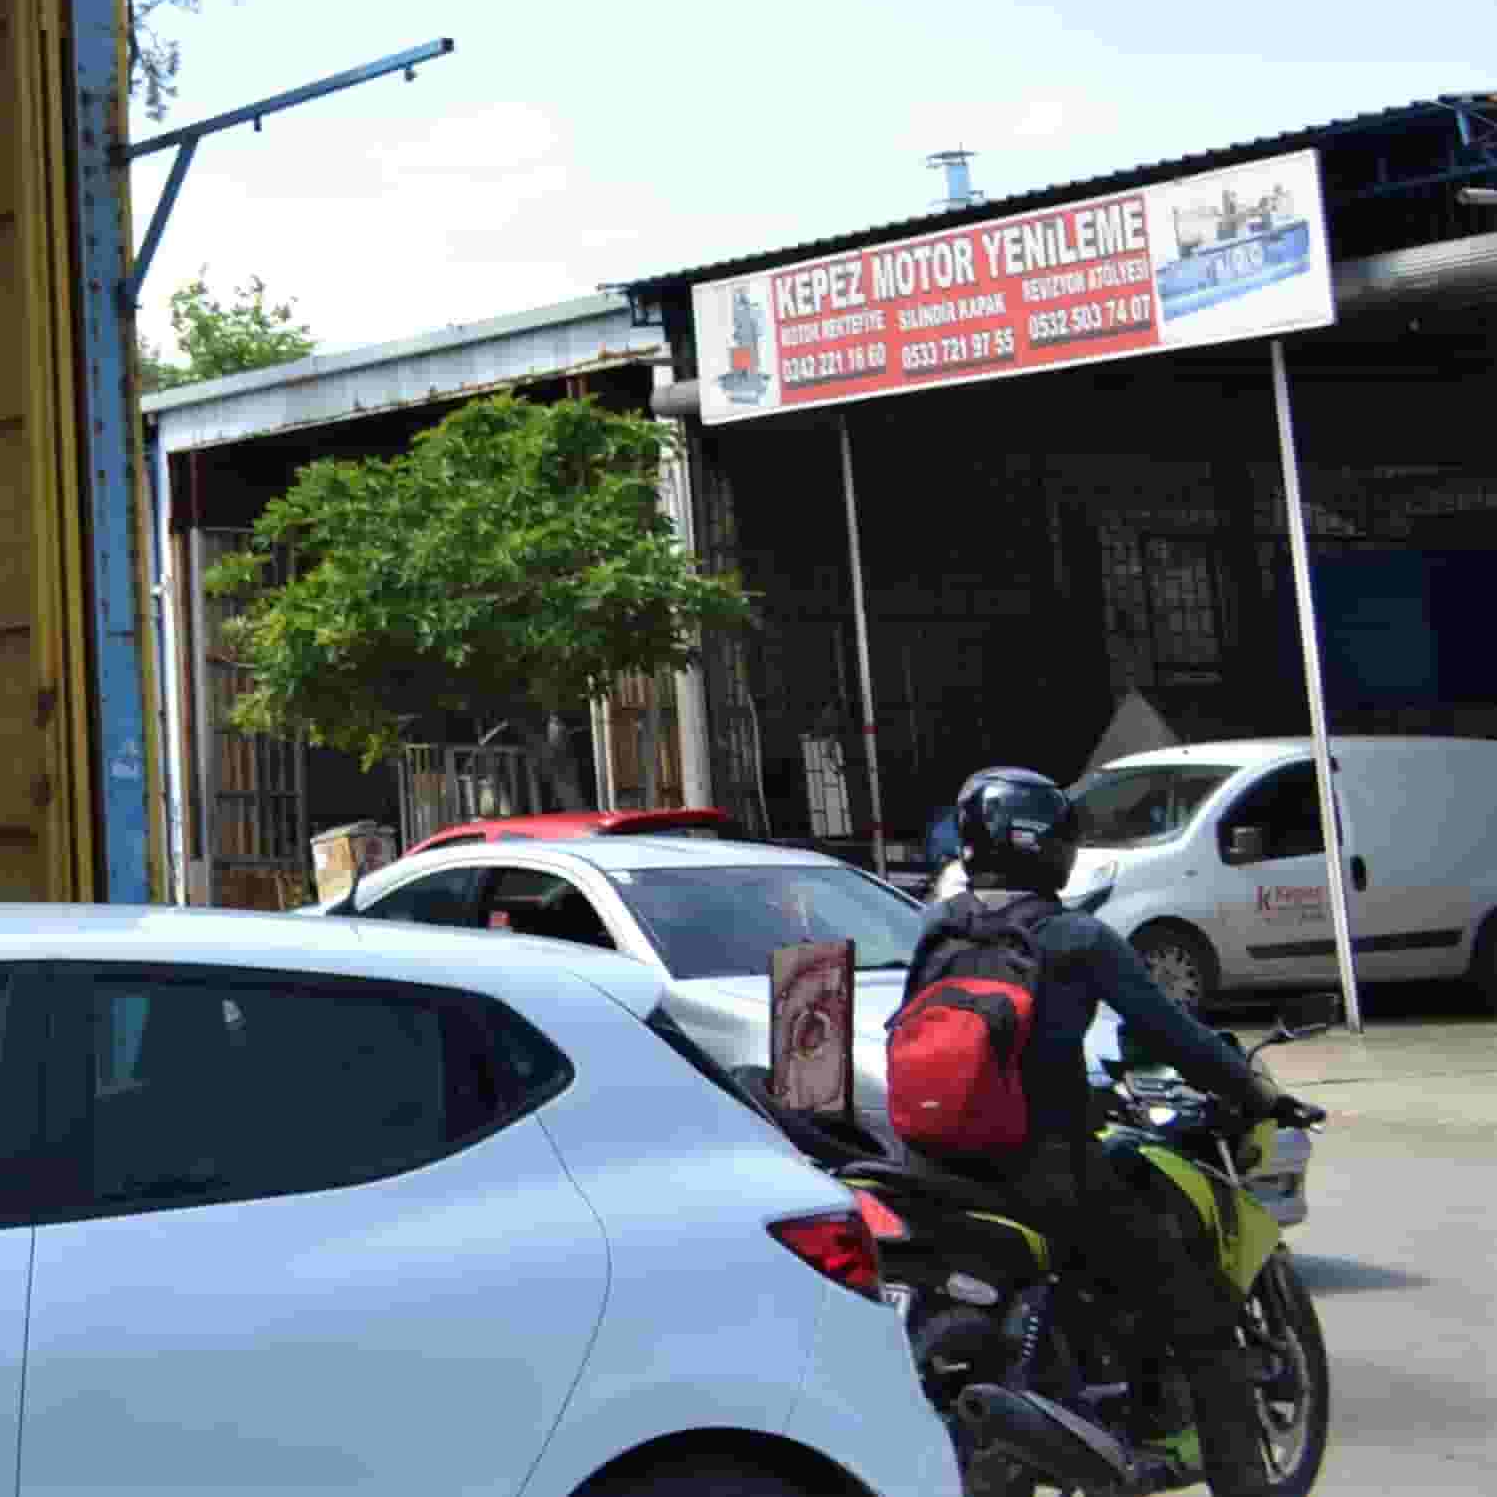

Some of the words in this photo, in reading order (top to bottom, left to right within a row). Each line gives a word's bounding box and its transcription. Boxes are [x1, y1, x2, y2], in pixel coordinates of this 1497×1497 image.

[777, 260, 864, 316] KEPEZ
[872, 237, 973, 301] MOTOR
[958, 292, 1005, 321] KAPAK
[1028, 309, 1068, 339] 0532
[1104, 298, 1128, 326] 74
[1130, 293, 1151, 321] 07
[902, 341, 936, 369] 0533
